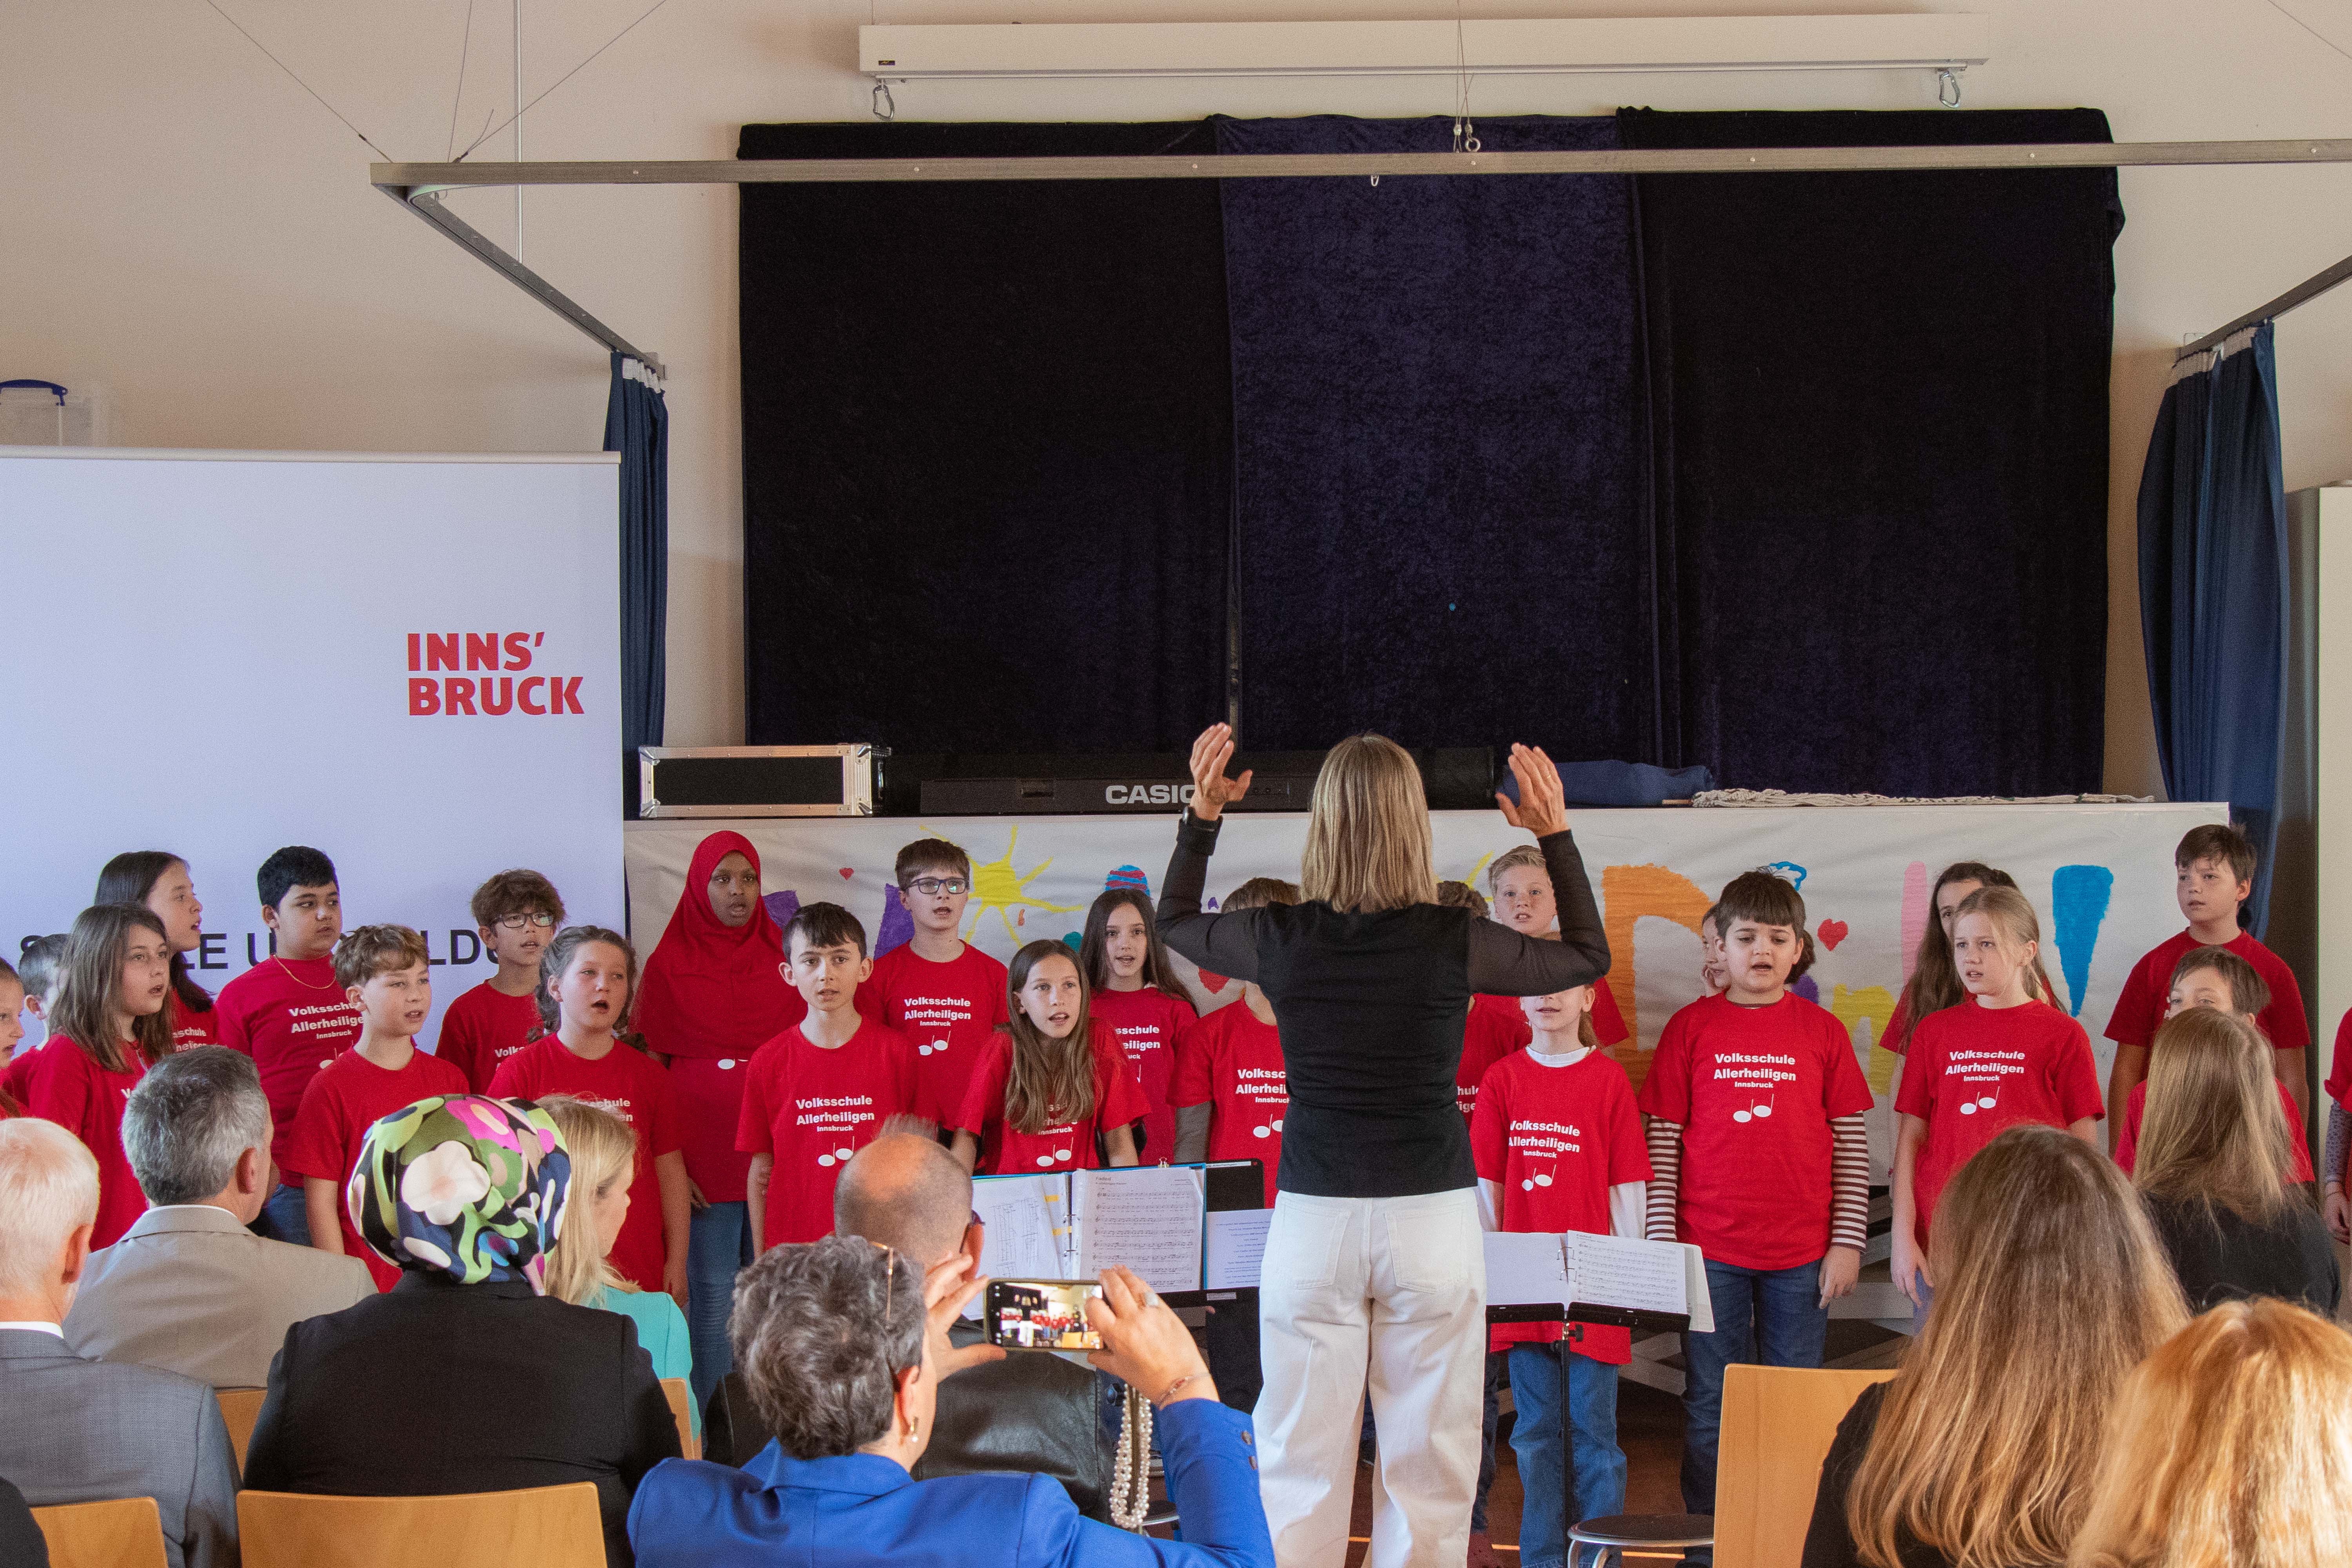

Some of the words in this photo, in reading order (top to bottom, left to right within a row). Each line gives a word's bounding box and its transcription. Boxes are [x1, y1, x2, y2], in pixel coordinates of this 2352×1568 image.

[408, 632, 544, 671] INNS'
[408, 676, 585, 716] BRUCK
[904, 997, 971, 1007] Volksschule
[289, 1002, 354, 1016] Volkssch
[904, 1009, 971, 1020] Allerheiligen
[291, 1016, 364, 1033] Allerheilige
[1115, 1025, 1160, 1034] sschule
[172, 1027, 207, 1038] sschule
[316, 1030, 352, 1039] Innsbruck
[1123, 1040, 1160, 1051] eiligen
[1715, 1053, 1795, 1065] Volksschule
[1949, 1050, 2025, 1060] Volksschule
[1237, 1068, 1286, 1079] Volkssc
[1714, 1068, 1796, 1081] Allerheiligen
[1945, 1063, 2024, 1075] Allerheiligen
[1235, 1083, 1287, 1094] Allerheil
[796, 1096, 872, 1109] Volksschule
[797, 1112, 875, 1125] Allerheiligen
[1510, 1120, 1580, 1136] Volksschule
[1509, 1136, 1580, 1152] Allerheiligen
